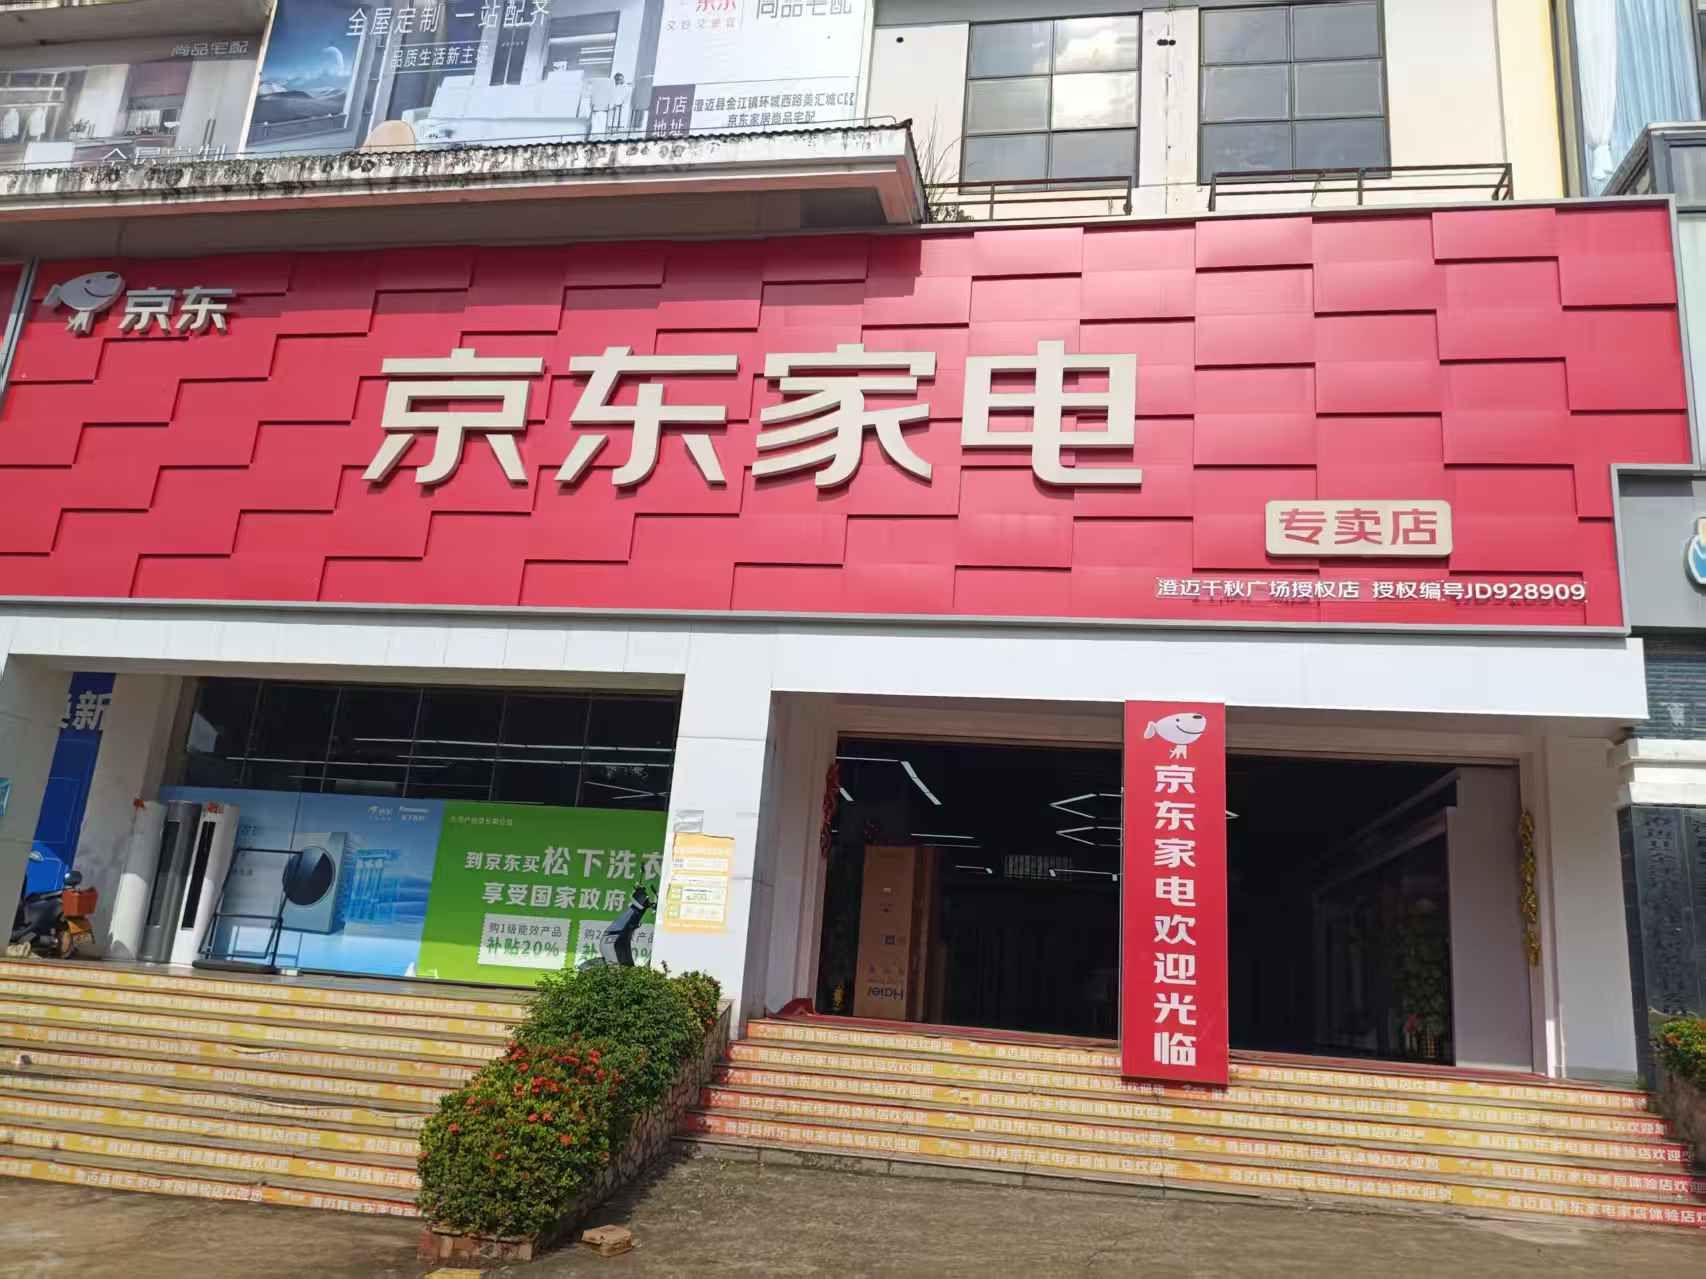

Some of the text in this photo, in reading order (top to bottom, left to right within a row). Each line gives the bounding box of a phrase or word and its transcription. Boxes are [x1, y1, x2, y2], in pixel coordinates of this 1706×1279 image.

[346, 0, 550, 36] 全屋定制 一站配齐
[655, 95, 688, 115] 门店
[120, 286, 234, 336] 京东
[361, 340, 1143, 488] 京东家电
[1278, 507, 1438, 546] 专卖店
[1156, 577, 1587, 602] 澄迈千秋广场授权店 授权编号JD928909
[489, 922, 562, 937] 购1级能效产品
[1153, 765, 1197, 1067] 京东家电欢迎光临
[486, 936, 560, 957] 补贴20%
